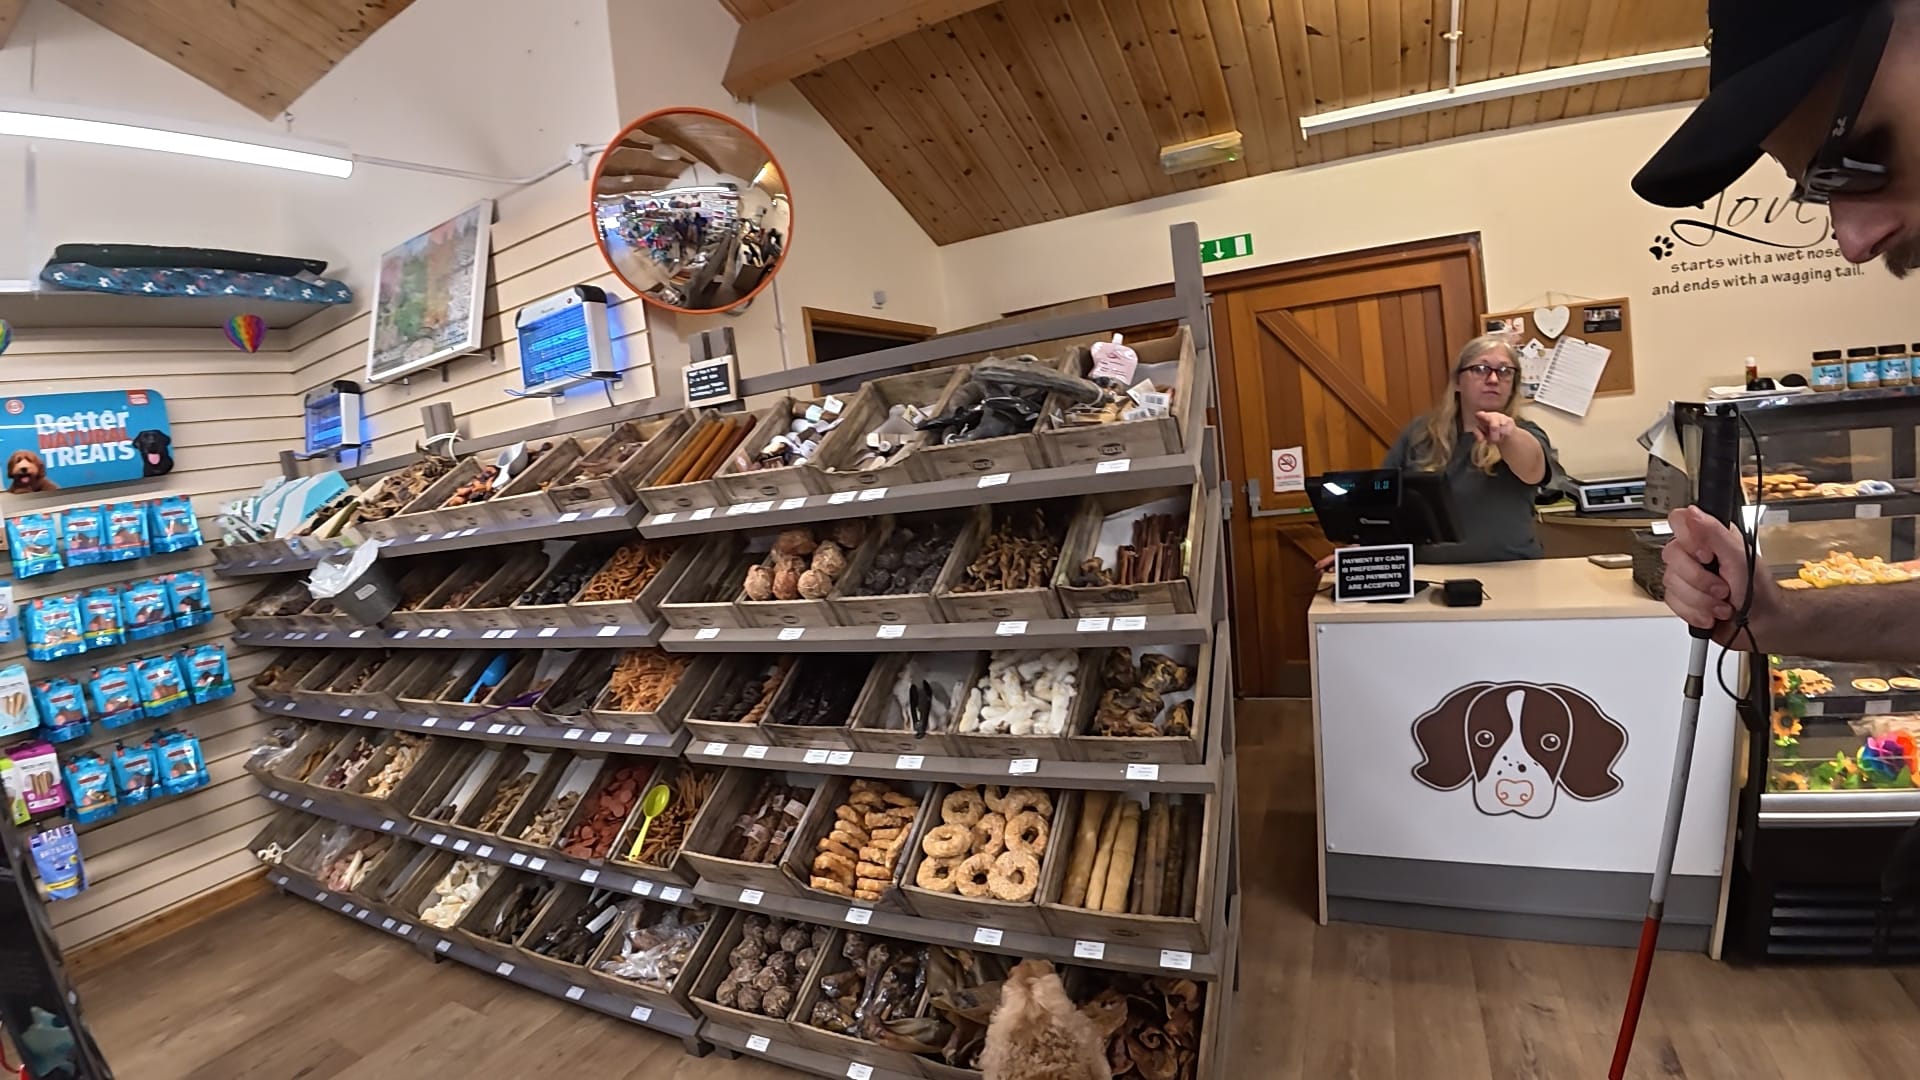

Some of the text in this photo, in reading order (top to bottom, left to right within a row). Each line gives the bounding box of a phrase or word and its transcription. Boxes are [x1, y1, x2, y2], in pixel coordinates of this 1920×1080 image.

[1671, 257, 1725, 273] starts
[1727, 252, 1762, 267] with
[1764, 254, 1773, 264] a
[1776, 249, 1805, 262] wet
[1651, 264, 1865, 296] and ends with a wagging tail.
[34, 409, 130, 436] Better
[38, 426, 130, 449] NATURAL
[40, 440, 136, 469] TREATS
[1342, 556, 1373, 565] PAYMENT
[1350, 564, 1390, 573] PREFERRED
[1363, 581, 1401, 590] ACCEPTED
[1366, 572, 1403, 581] PAYMENTS
